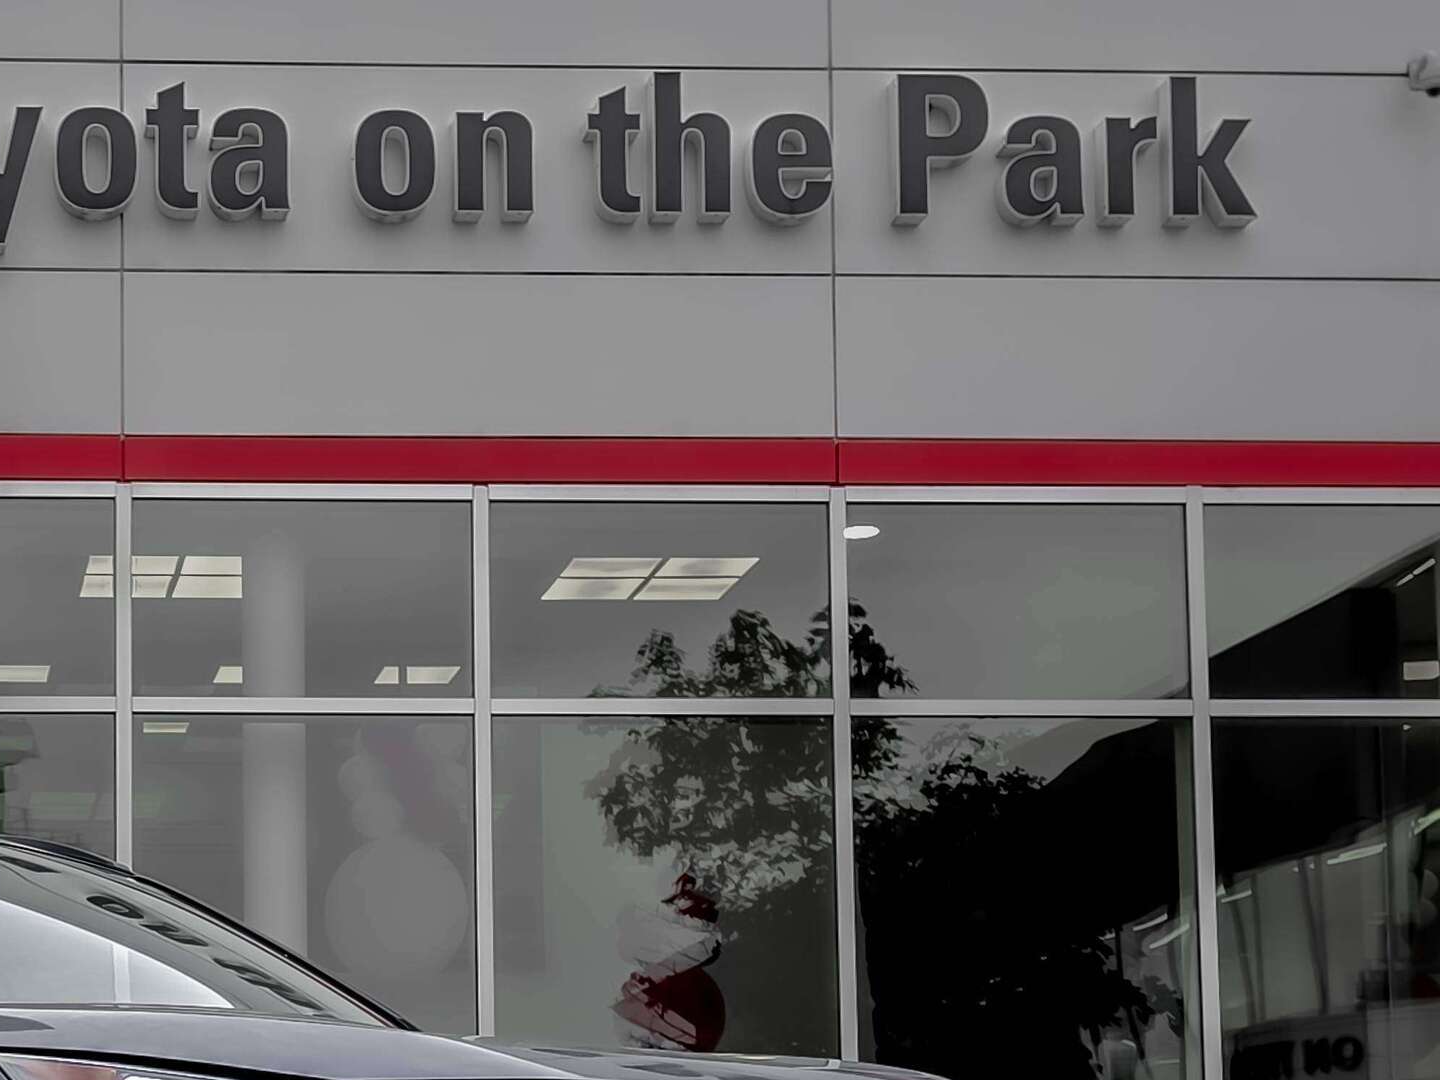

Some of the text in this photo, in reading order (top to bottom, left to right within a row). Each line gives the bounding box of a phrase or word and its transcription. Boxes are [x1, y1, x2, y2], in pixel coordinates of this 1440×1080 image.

[353, 107, 536, 224] on
[582, 70, 834, 226] the
[890, 72, 1260, 229] Park
